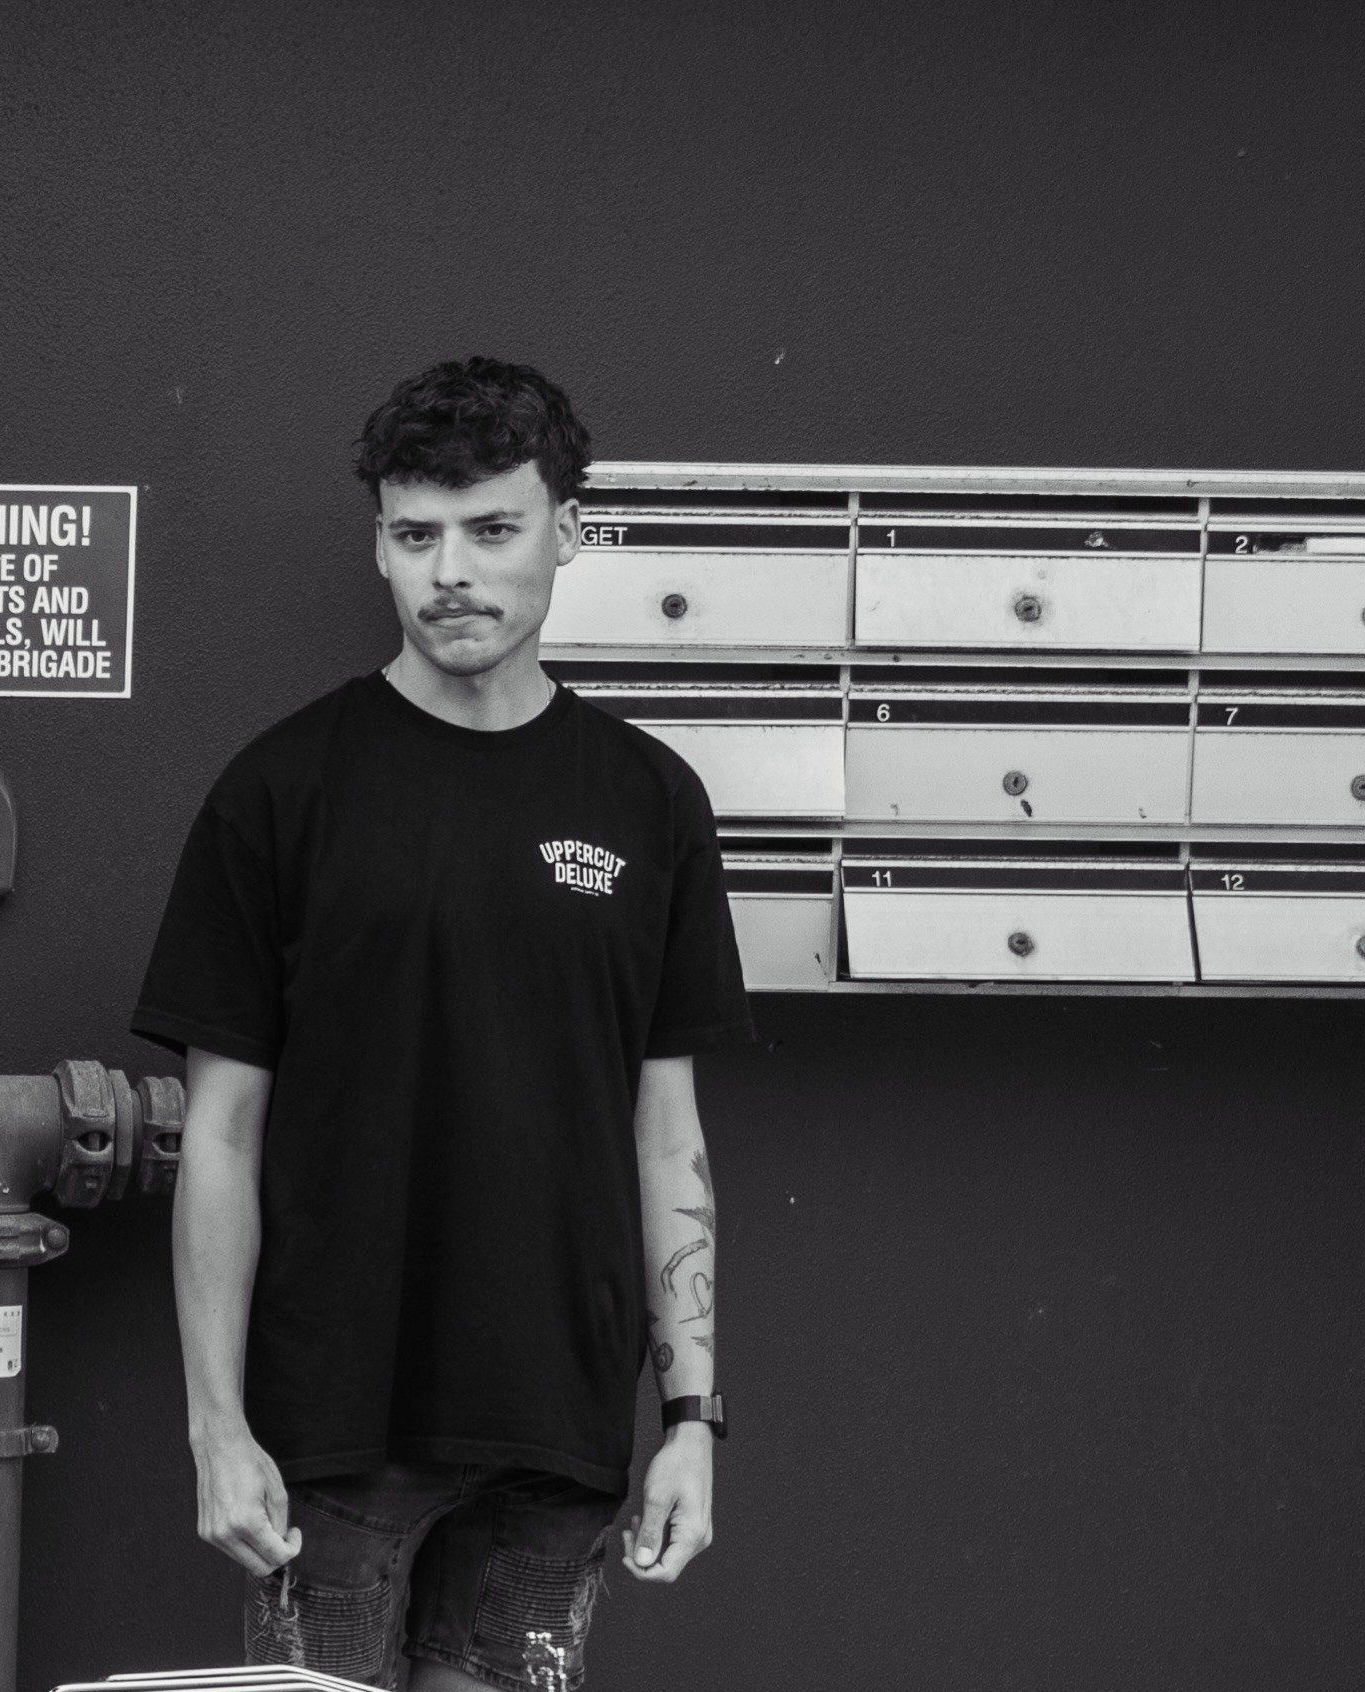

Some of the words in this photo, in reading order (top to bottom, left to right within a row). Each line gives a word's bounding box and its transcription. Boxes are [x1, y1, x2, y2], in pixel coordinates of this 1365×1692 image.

[885, 528, 897, 547] 1
[1234, 535, 1249, 554] 2
[23, 554, 59, 582] OF
[32, 586, 89, 615] AND
[40, 618, 107, 647] WILL
[875, 703, 890, 723] 6
[1225, 707, 1239, 726] 7
[539, 840, 626, 878] UPPERCUT
[555, 862, 613, 895] DELUXE
[870, 870, 894, 888] 11
[1219, 873, 1245, 891] 12
